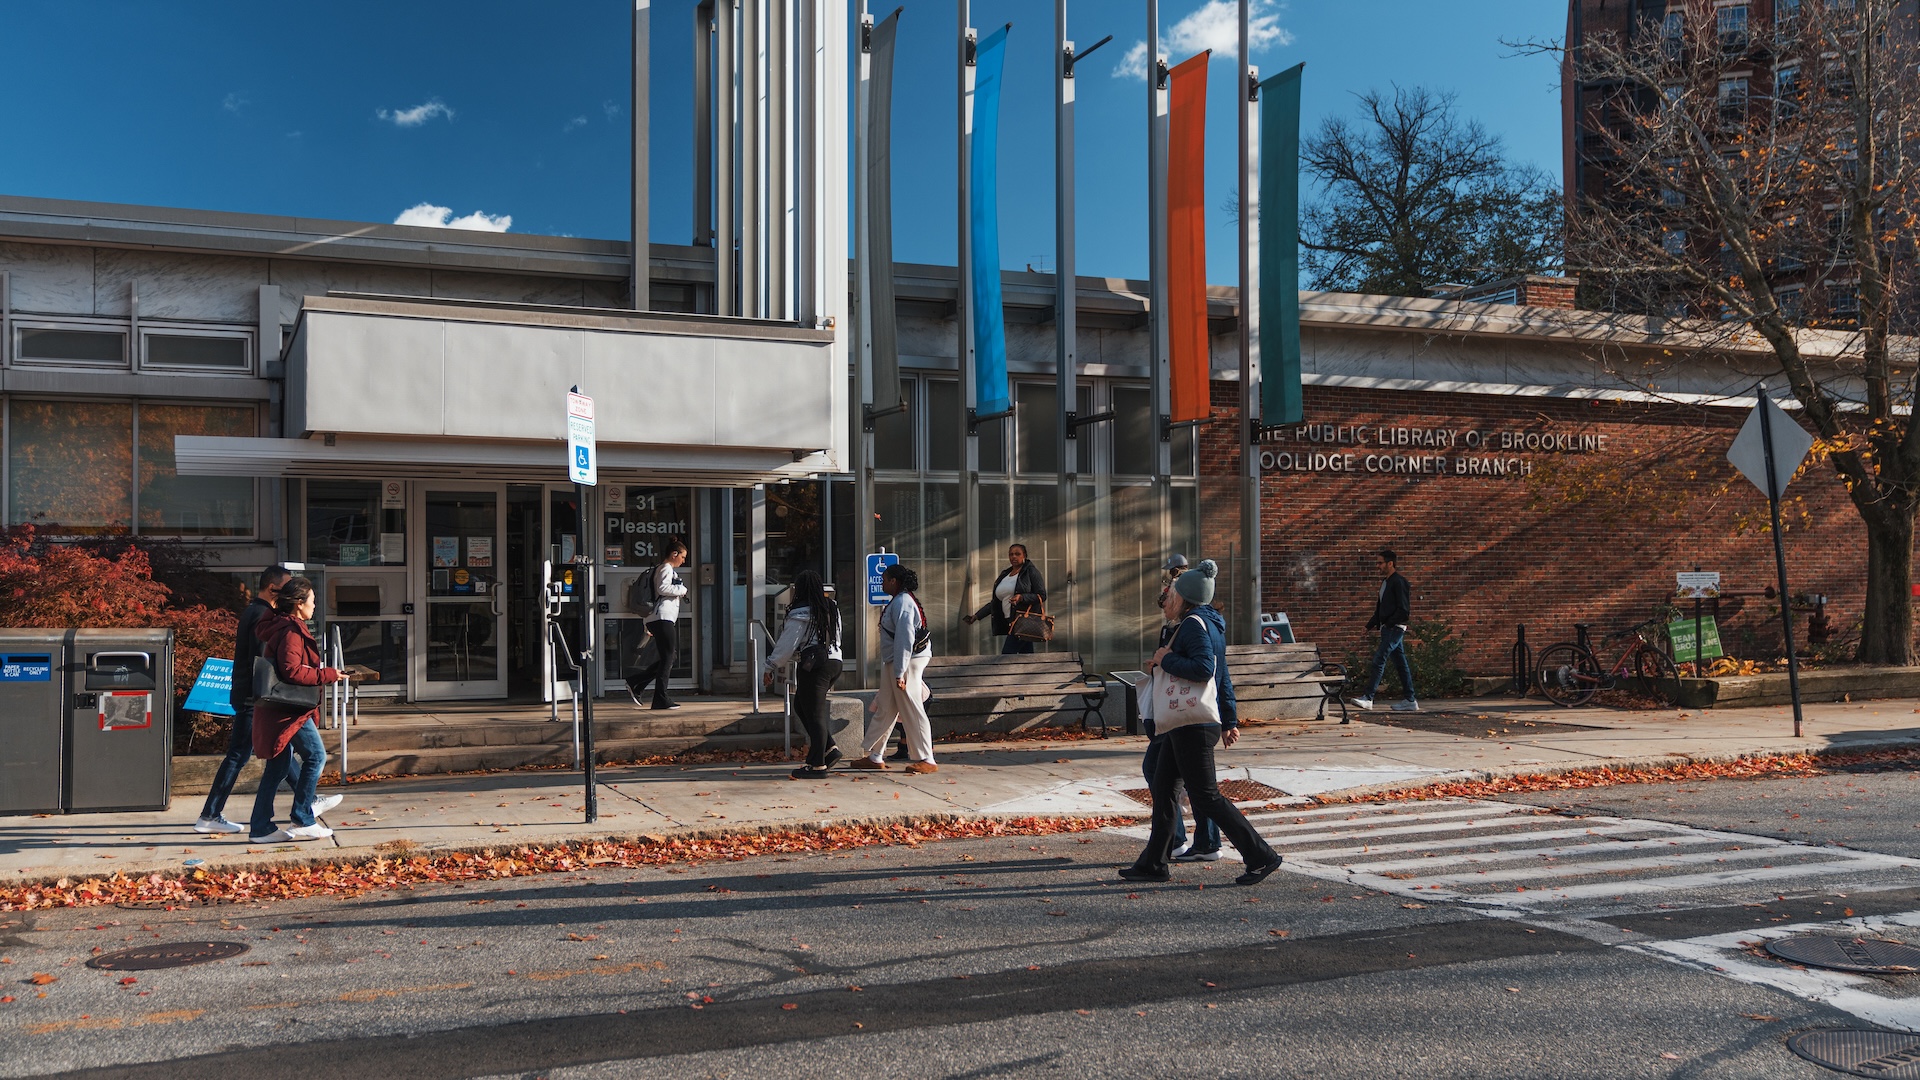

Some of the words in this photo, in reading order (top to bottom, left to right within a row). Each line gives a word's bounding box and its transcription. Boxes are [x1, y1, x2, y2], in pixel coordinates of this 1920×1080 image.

[575, 406, 587, 414] ZONE
[570, 421, 592, 434] RESERVED
[573, 433, 591, 445] PARKING
[1295, 424, 1369, 443] PUBLIC
[1379, 427, 1458, 447] LIBRARY
[1465, 430, 1493, 447] OF
[1501, 431, 1608, 451] BROOKLINE
[1260, 451, 1356, 471] OOLIDGE
[1365, 454, 1446, 473] CORNER
[1455, 457, 1531, 475] BRANCH
[636, 495, 655, 510] 31
[607, 517, 686, 534] Pleasant
[634, 541, 658, 557] St.
[1672, 634, 1696, 644] TEAM
[1675, 638, 1718, 651] BROOLINE
[206, 664, 230, 673] YOU'RE
